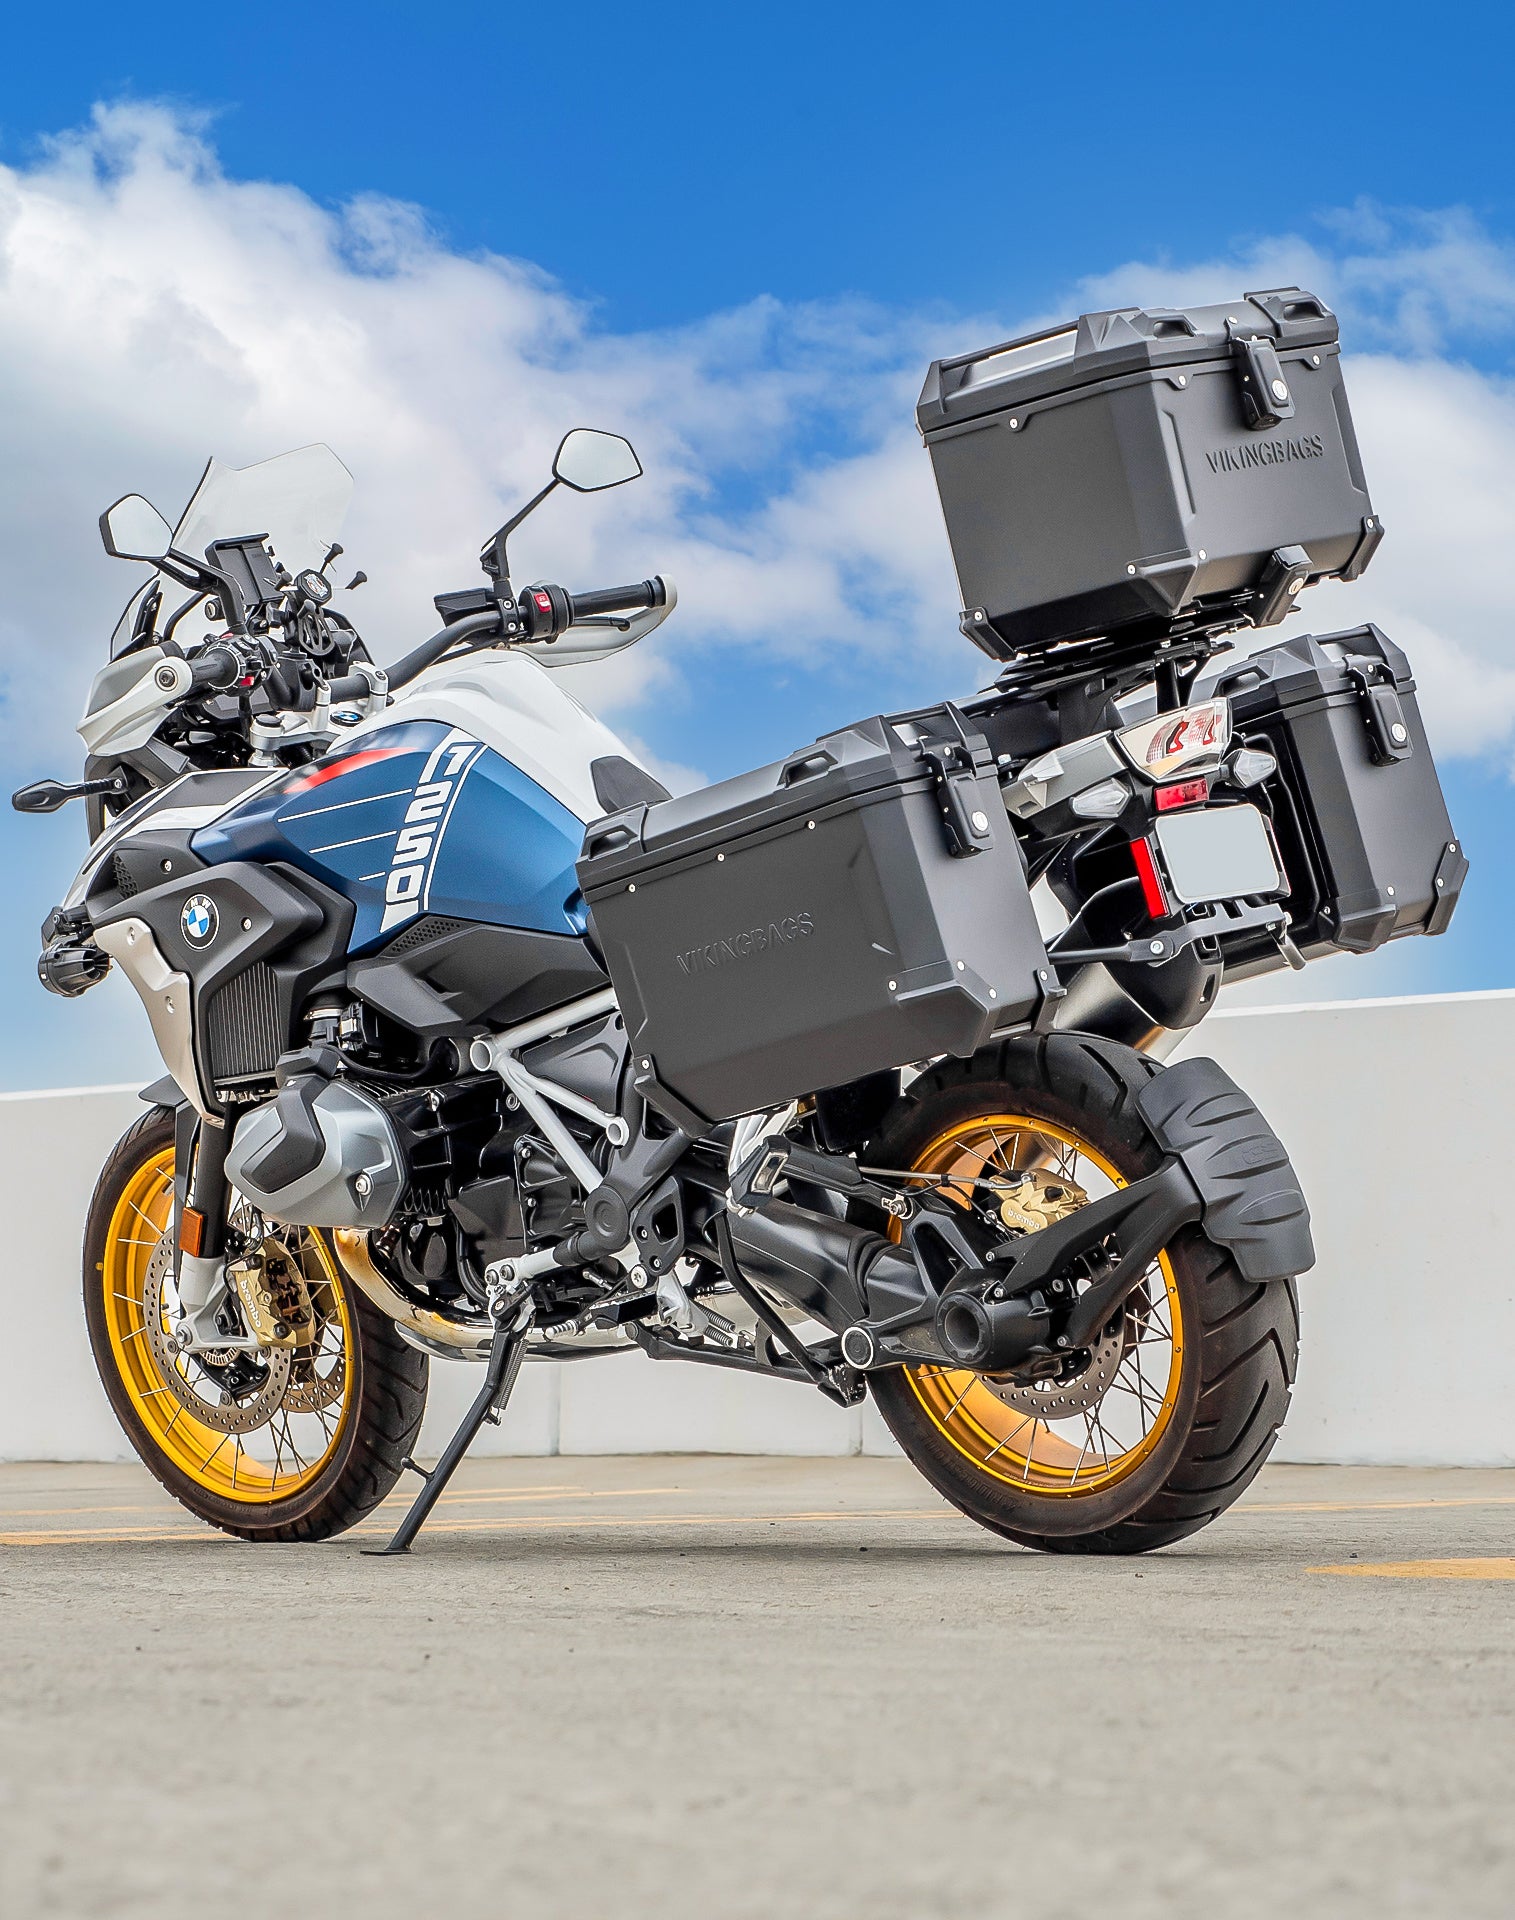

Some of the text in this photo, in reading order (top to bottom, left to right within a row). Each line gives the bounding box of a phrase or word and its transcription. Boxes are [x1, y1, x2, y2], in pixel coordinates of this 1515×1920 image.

[1205, 434, 1325, 474] VIKINGBAGS
[385, 744, 477, 905] 1250
[182, 897, 212, 920] BMW
[676, 912, 814, 976] VIKINGBAGS
[1008, 1208, 1041, 1230] brembo
[240, 1279, 262, 1328] brembo
